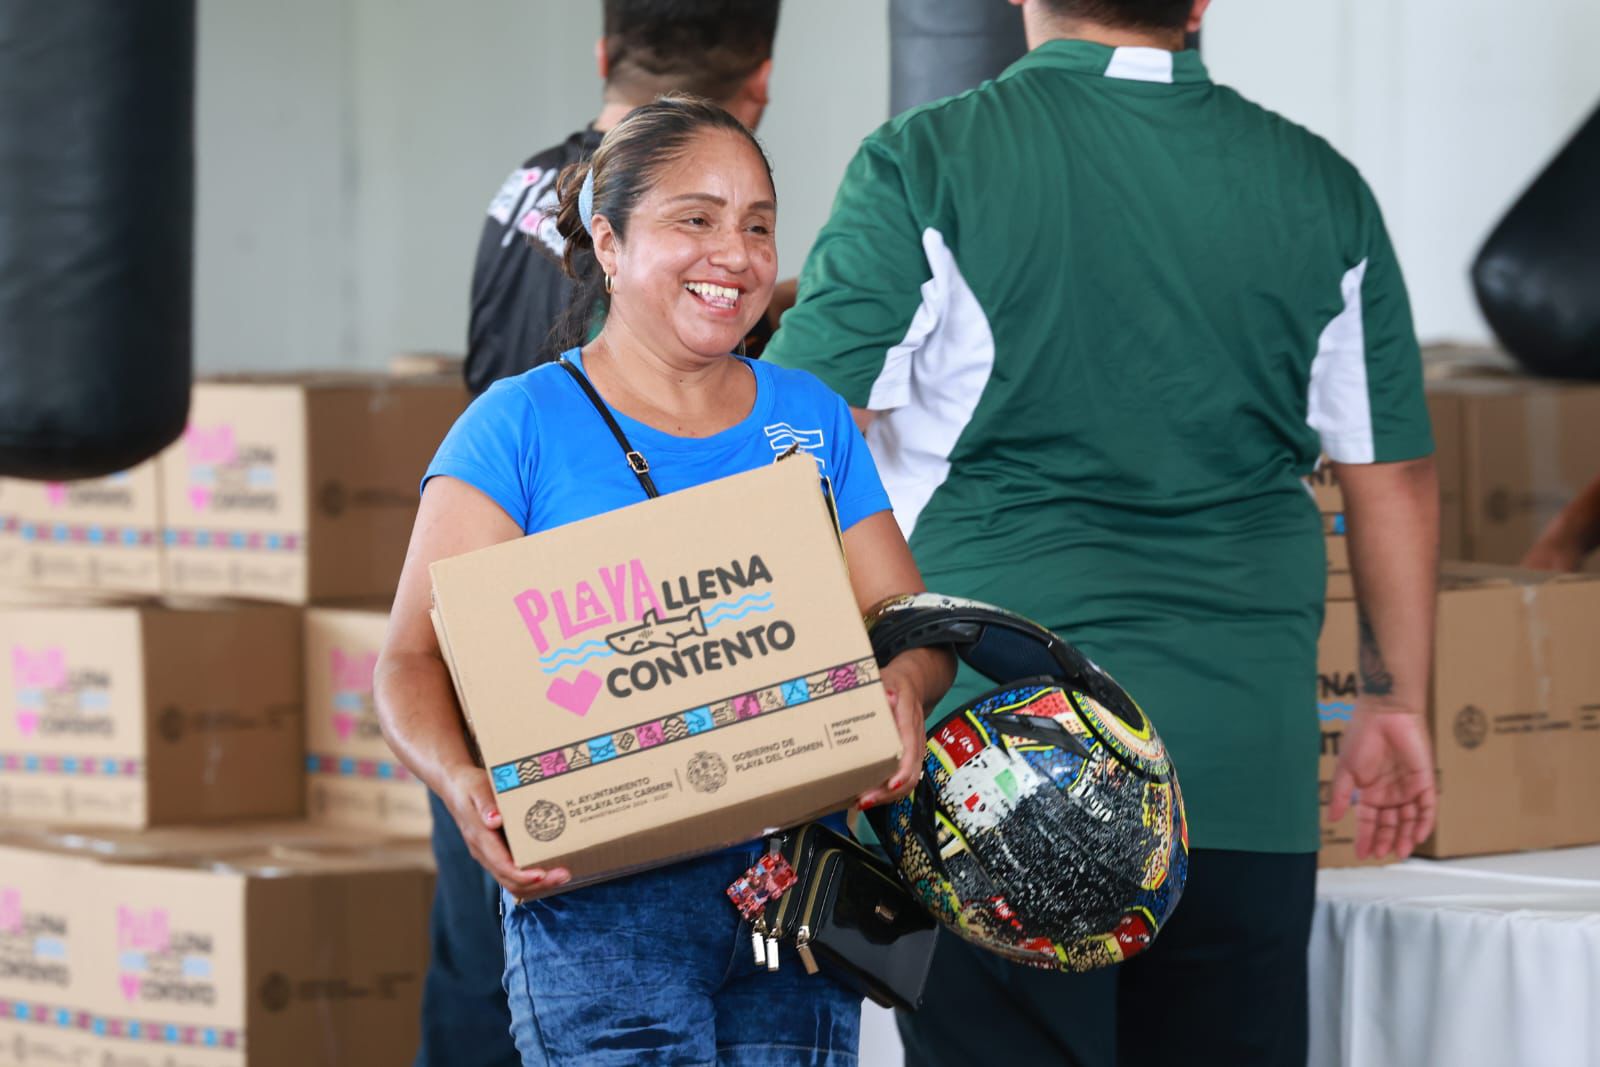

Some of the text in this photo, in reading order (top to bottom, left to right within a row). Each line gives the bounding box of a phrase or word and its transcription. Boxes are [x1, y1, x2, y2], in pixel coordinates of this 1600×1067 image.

[513, 555, 773, 655] PLAYA LLENA
[606, 620, 796, 698] CONTENTO
[732, 738, 795, 762] GOBIERNO DE
[735, 740, 824, 773] PLAYA DEL CARMEN
[569, 781, 673, 818] DE PLAYA DEL CARMEN
[578, 776, 650, 803] AYUNTAMIENTO
